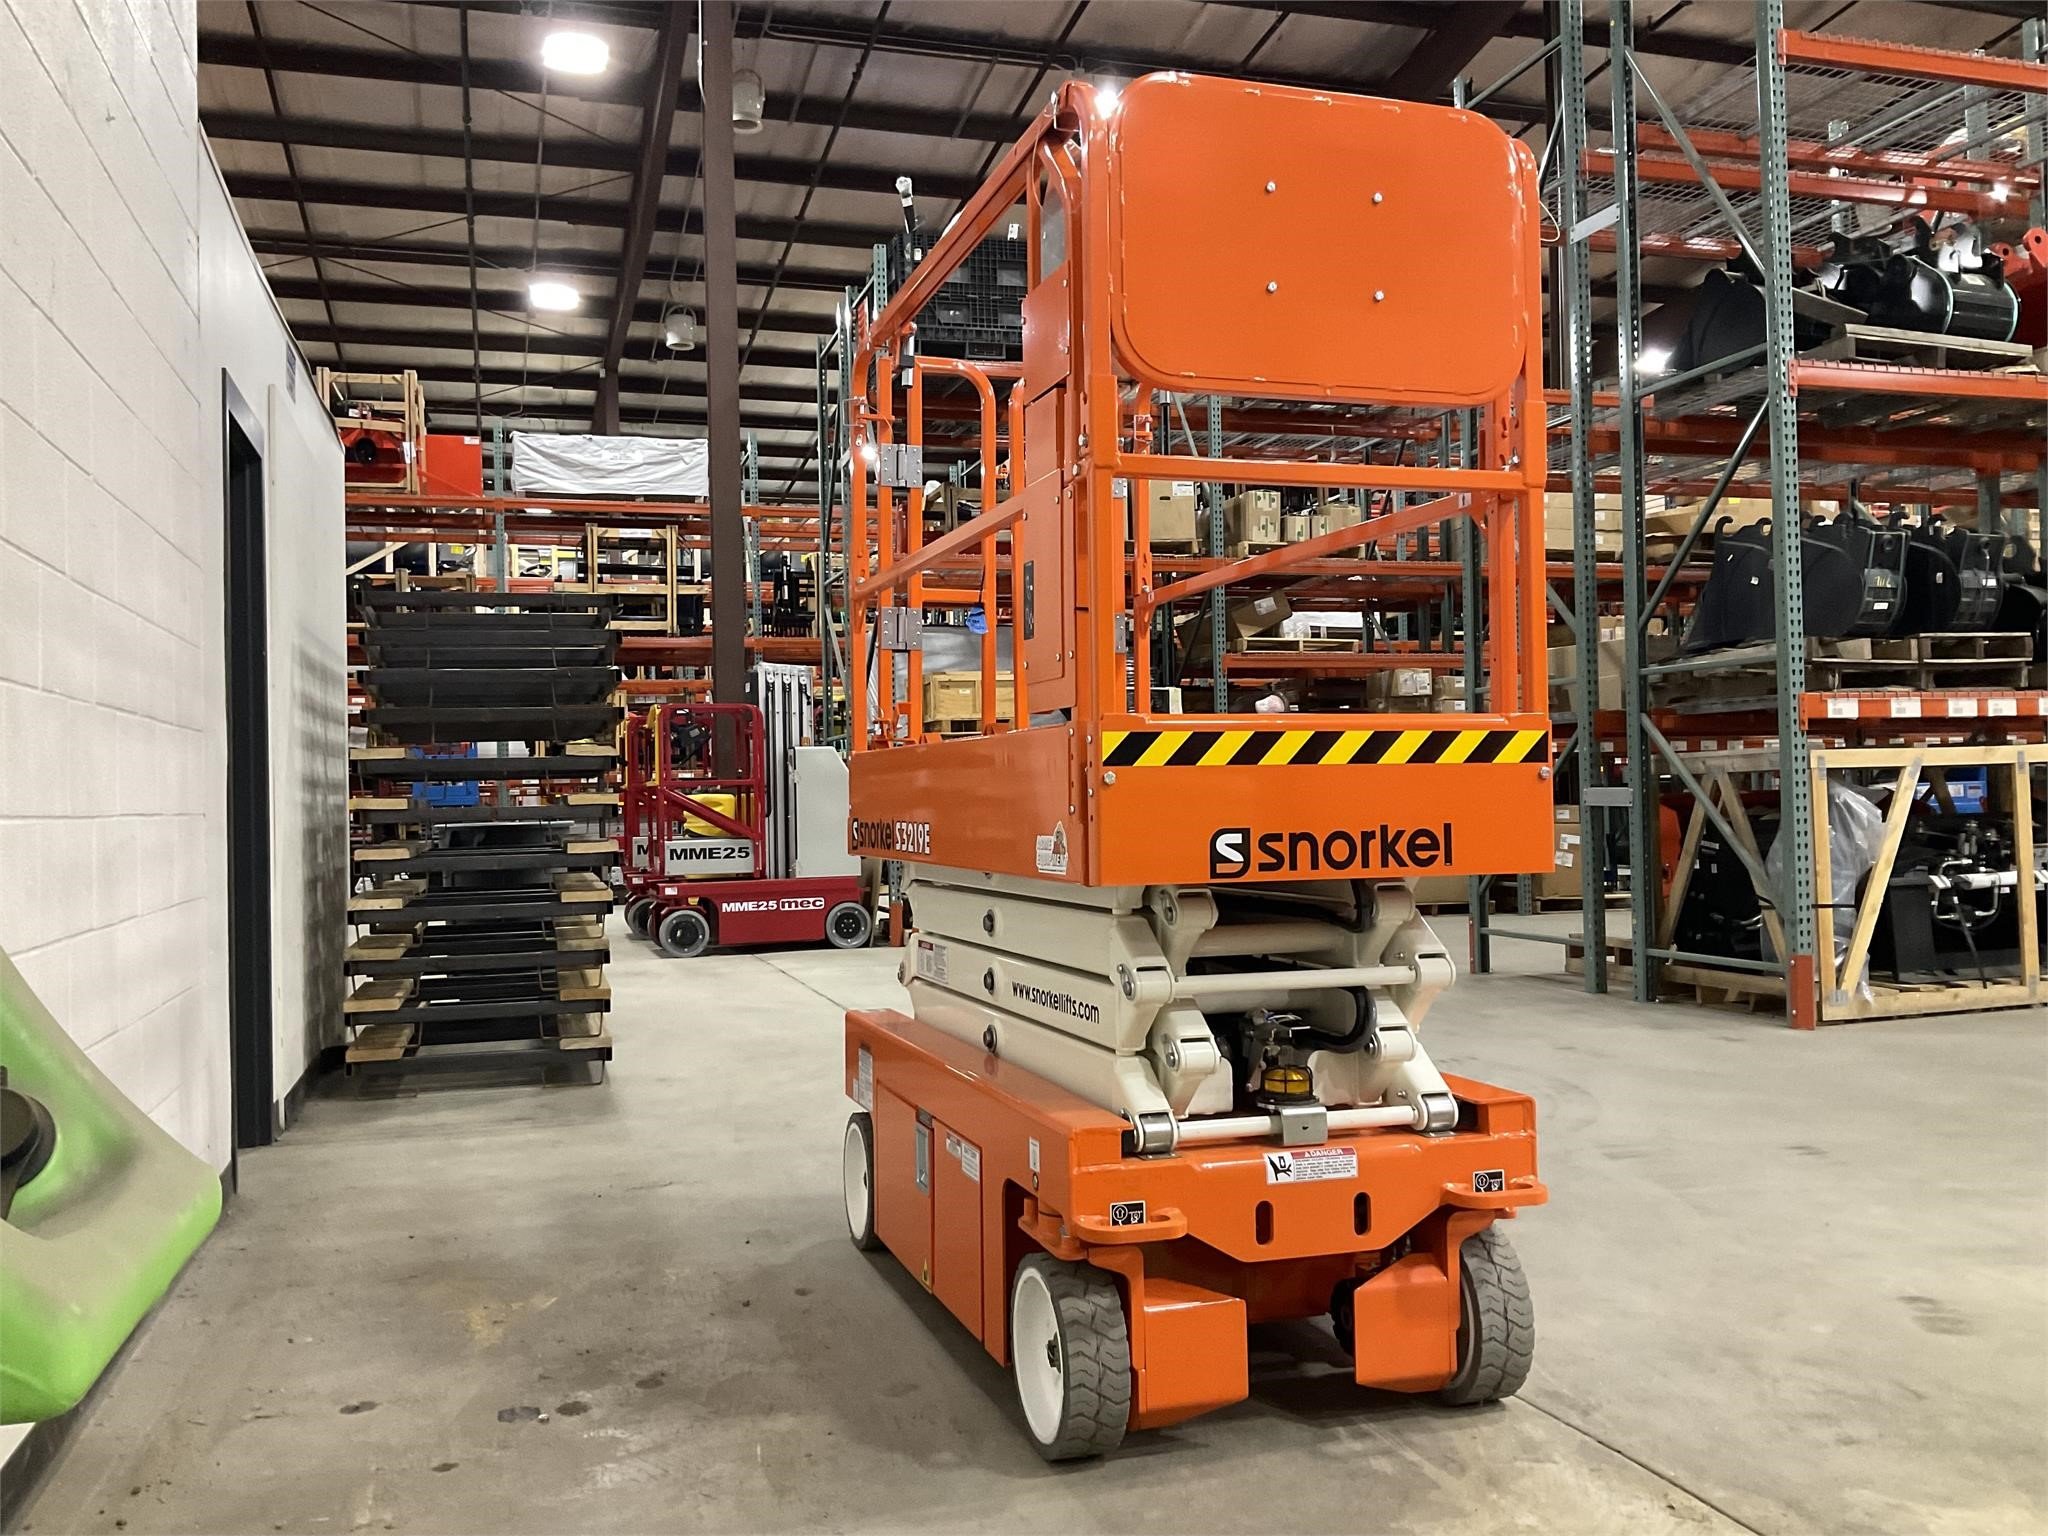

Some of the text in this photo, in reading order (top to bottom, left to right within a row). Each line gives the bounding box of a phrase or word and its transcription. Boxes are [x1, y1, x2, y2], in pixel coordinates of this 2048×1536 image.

[669, 846, 751, 861] MME25
[859, 818, 895, 850] snorkel
[895, 821, 931, 855] S3219E
[1258, 823, 1453, 872] snorkel
[721, 898, 824, 913] MME25 mec
[1011, 980, 1101, 1025] www.snorkellifts.com
